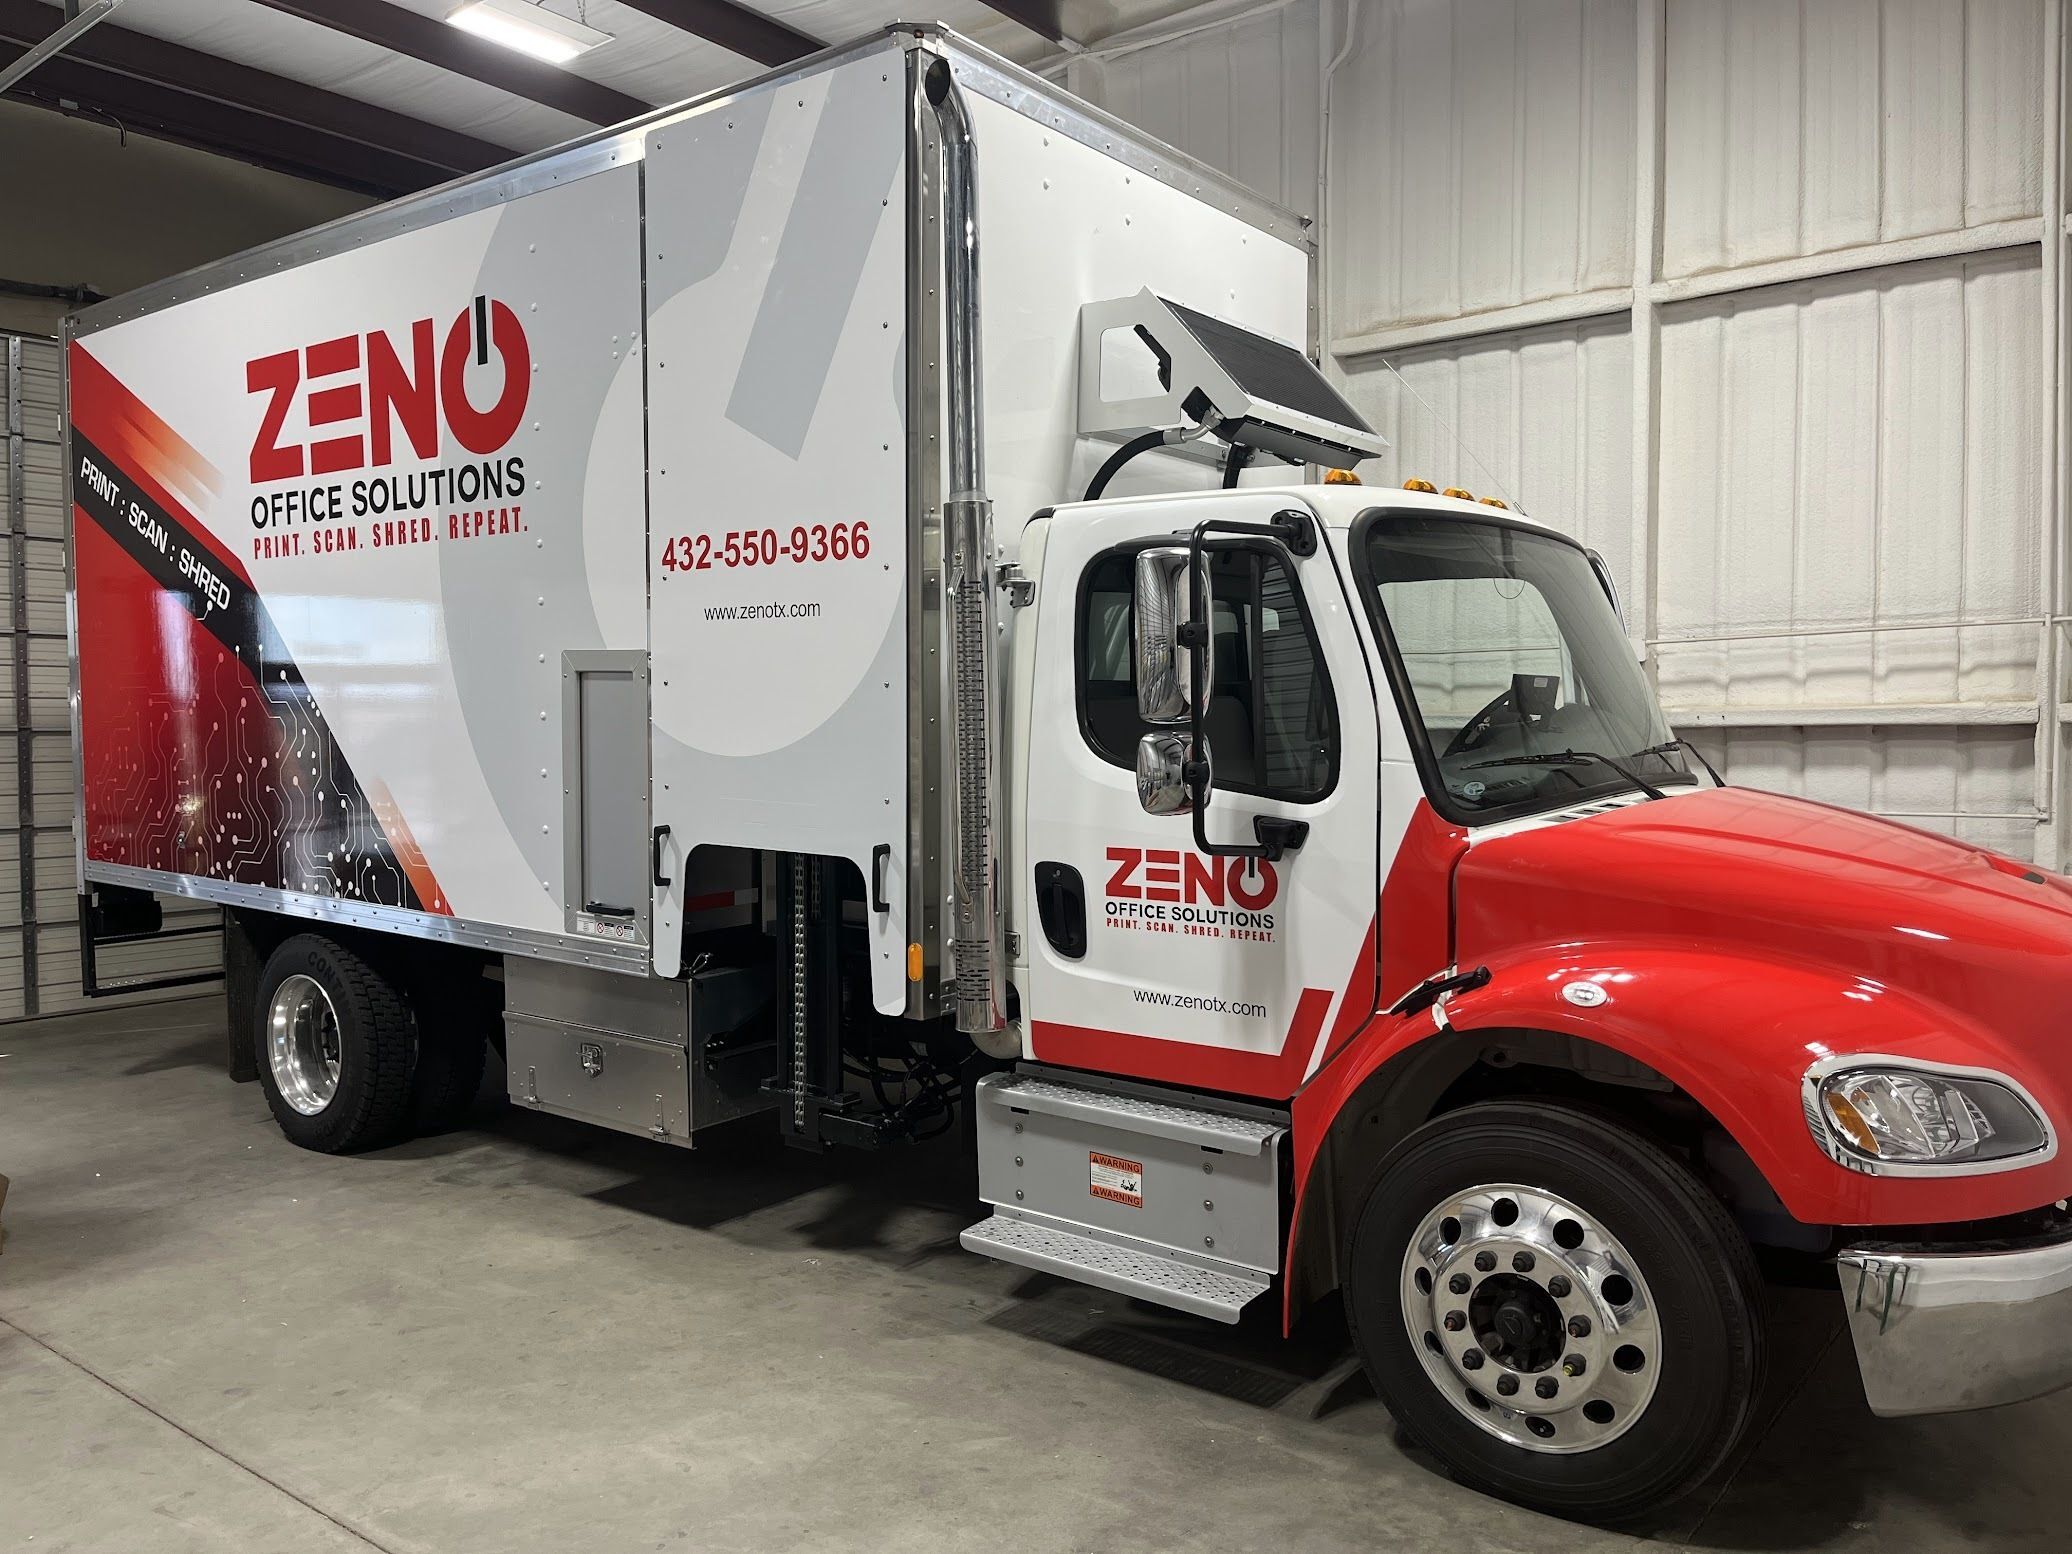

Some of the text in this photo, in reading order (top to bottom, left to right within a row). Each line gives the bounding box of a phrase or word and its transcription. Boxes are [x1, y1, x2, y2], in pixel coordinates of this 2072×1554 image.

[246, 296, 530, 485] ZENO
[251, 457, 526, 529] OFFICE SOLUTIONS
[80, 456, 120, 507] PRINT
[128, 501, 169, 554] SCAN
[178, 548, 231, 610] SHRED
[254, 506, 528, 560] PRINT. SCAN. SHRED. REPEAT.
[661, 521, 871, 571] 432-550-9366
[703, 602, 821, 620] www.zenotx.com
[1105, 846, 1279, 911] ZENO
[1105, 901, 1275, 930] OFFICE SOLUTIONS
[1106, 917, 1276, 943] PRINT. SCAN. SHRED. REPEAT.
[1133, 990, 1267, 1018] www.zenotx.com
[1100, 1156, 1140, 1173] WARNING
[1100, 1187, 1140, 1206] WARNING
